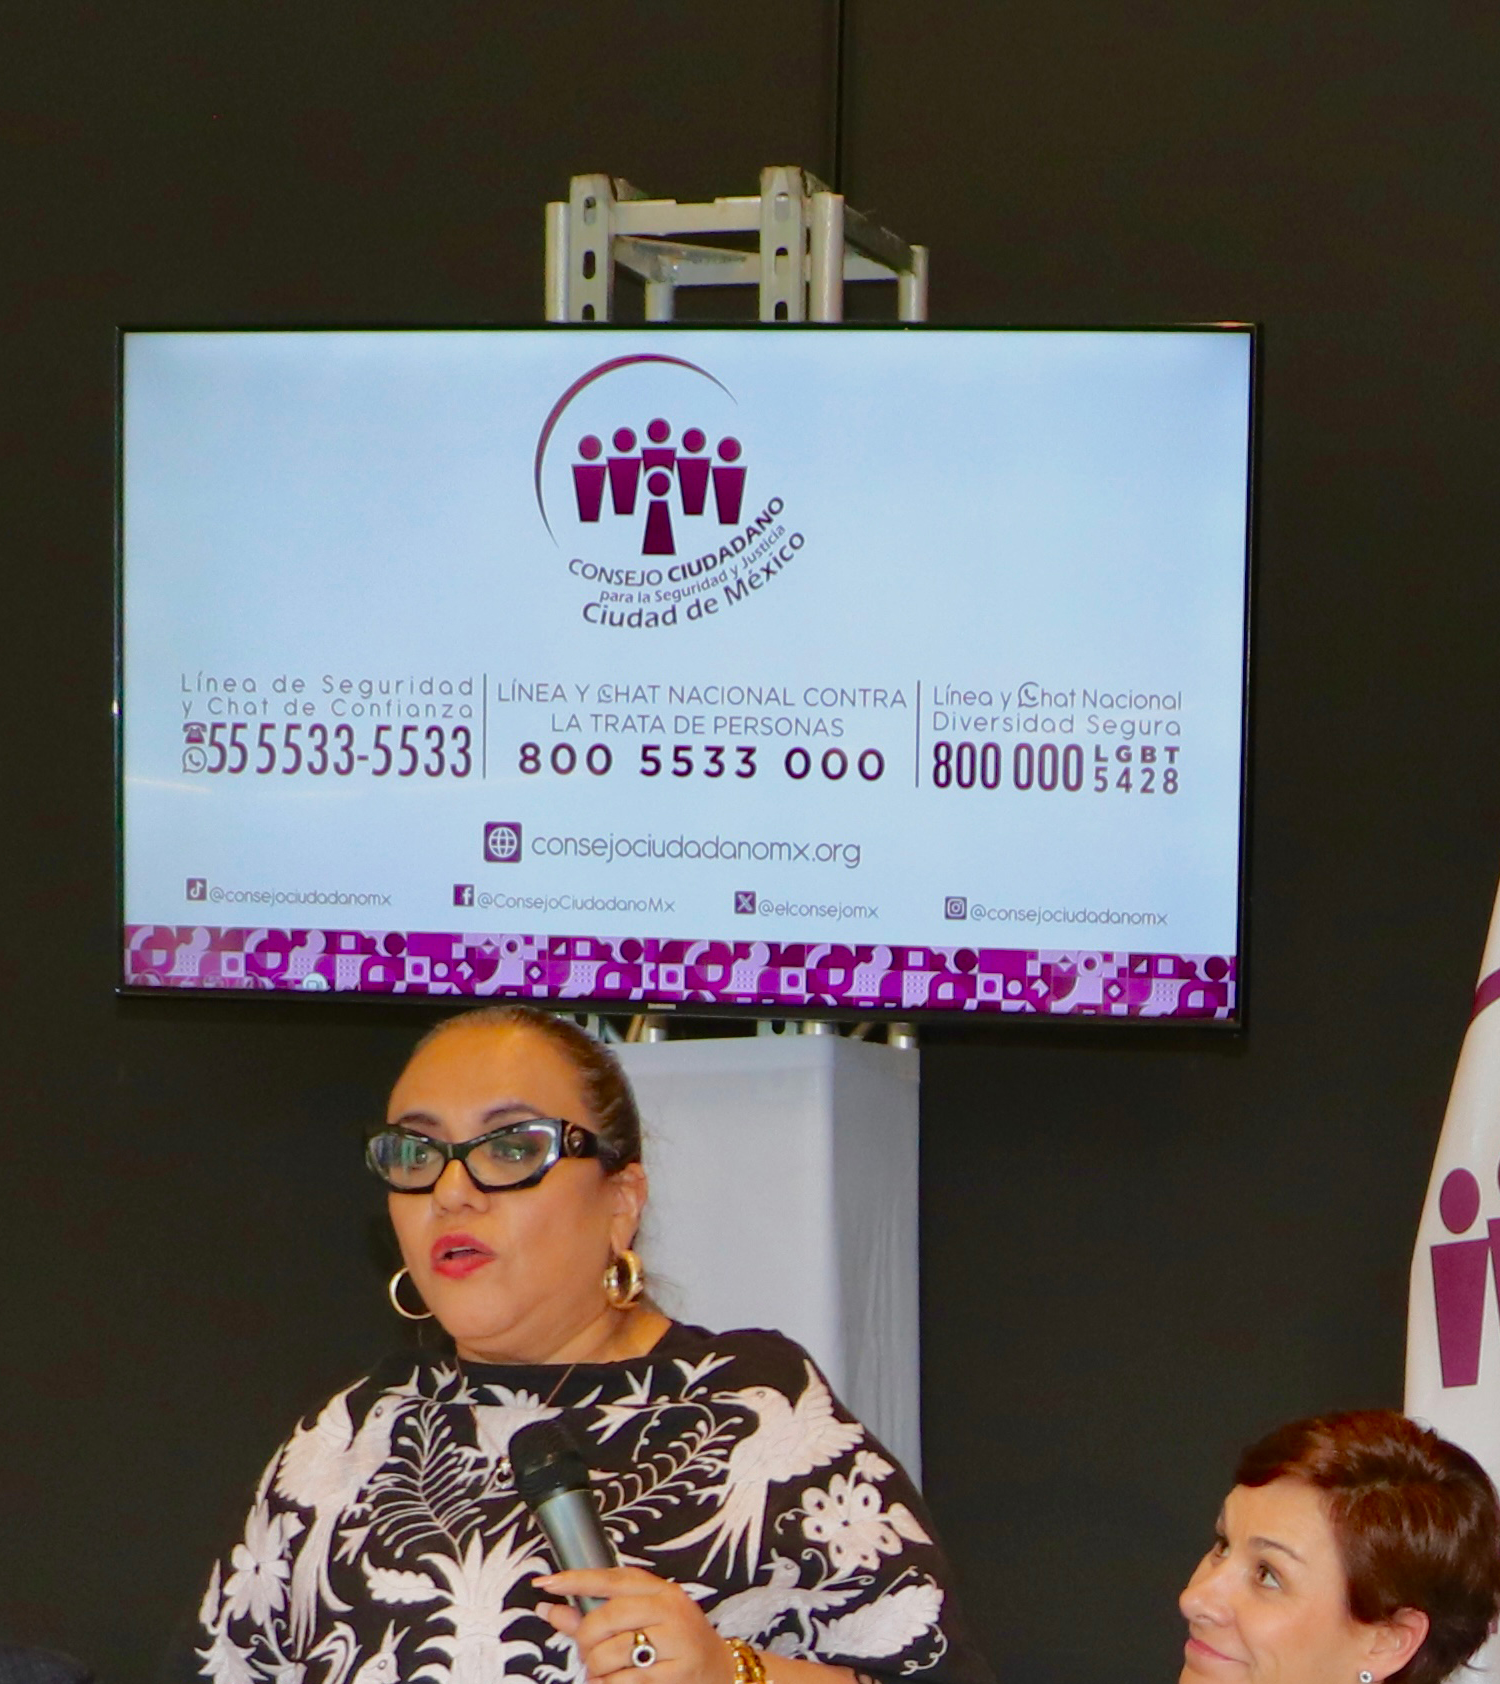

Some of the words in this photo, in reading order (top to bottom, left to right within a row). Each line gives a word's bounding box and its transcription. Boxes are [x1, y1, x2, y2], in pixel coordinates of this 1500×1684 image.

[568, 558, 663, 587] CONSEJO
[667, 496, 785, 583] CIUDADANO
[600, 590, 633, 604] para
[638, 590, 651, 604] la
[655, 569, 728, 604] Seguridad
[731, 564, 740, 580] y
[741, 524, 786, 570] Justicia
[582, 602, 677, 628] Ciudad
[686, 597, 720, 621] de
[723, 532, 805, 606] México
[181, 671, 256, 694] Línea
[272, 674, 306, 694] de
[322, 675, 473, 699] Seguridad
[497, 678, 567, 702] LÍNEA
[575, 684, 590, 702] Y
[597, 684, 661, 704] CHAT
[668, 685, 795, 707] NACIONAL
[803, 687, 907, 709] CONTRA
[933, 683, 993, 706] Línea
[1000, 692, 1012, 712] y
[1082, 688, 1182, 711] Nacional
[182, 700, 193, 719] y
[208, 696, 269, 716] Chat
[284, 698, 316, 717] de
[331, 698, 473, 719] Confianza
[551, 713, 582, 733] LA
[590, 714, 666, 734] TRATA
[673, 715, 705, 735] DE
[713, 717, 844, 738] PERSONAS
[933, 711, 1074, 733] Diversidad
[1087, 715, 1181, 740] Segura
[518, 742, 613, 776] 800
[640, 743, 757, 779] 5533
[784, 746, 885, 782] 000
[932, 740, 1002, 790] 800
[1013, 742, 1084, 792] 000
[1094, 744, 1180, 764] LGBT
[1094, 766, 1179, 795] 5428
[531, 833, 862, 869] consejociudadanomx.org
[209, 886, 392, 908] @consejociudadanomx
[477, 892, 676, 914] @ConsejoCiudadanoMx
[758, 899, 880, 920] @elconsejomx
[970, 903, 1168, 926] @consejociudadanomx
